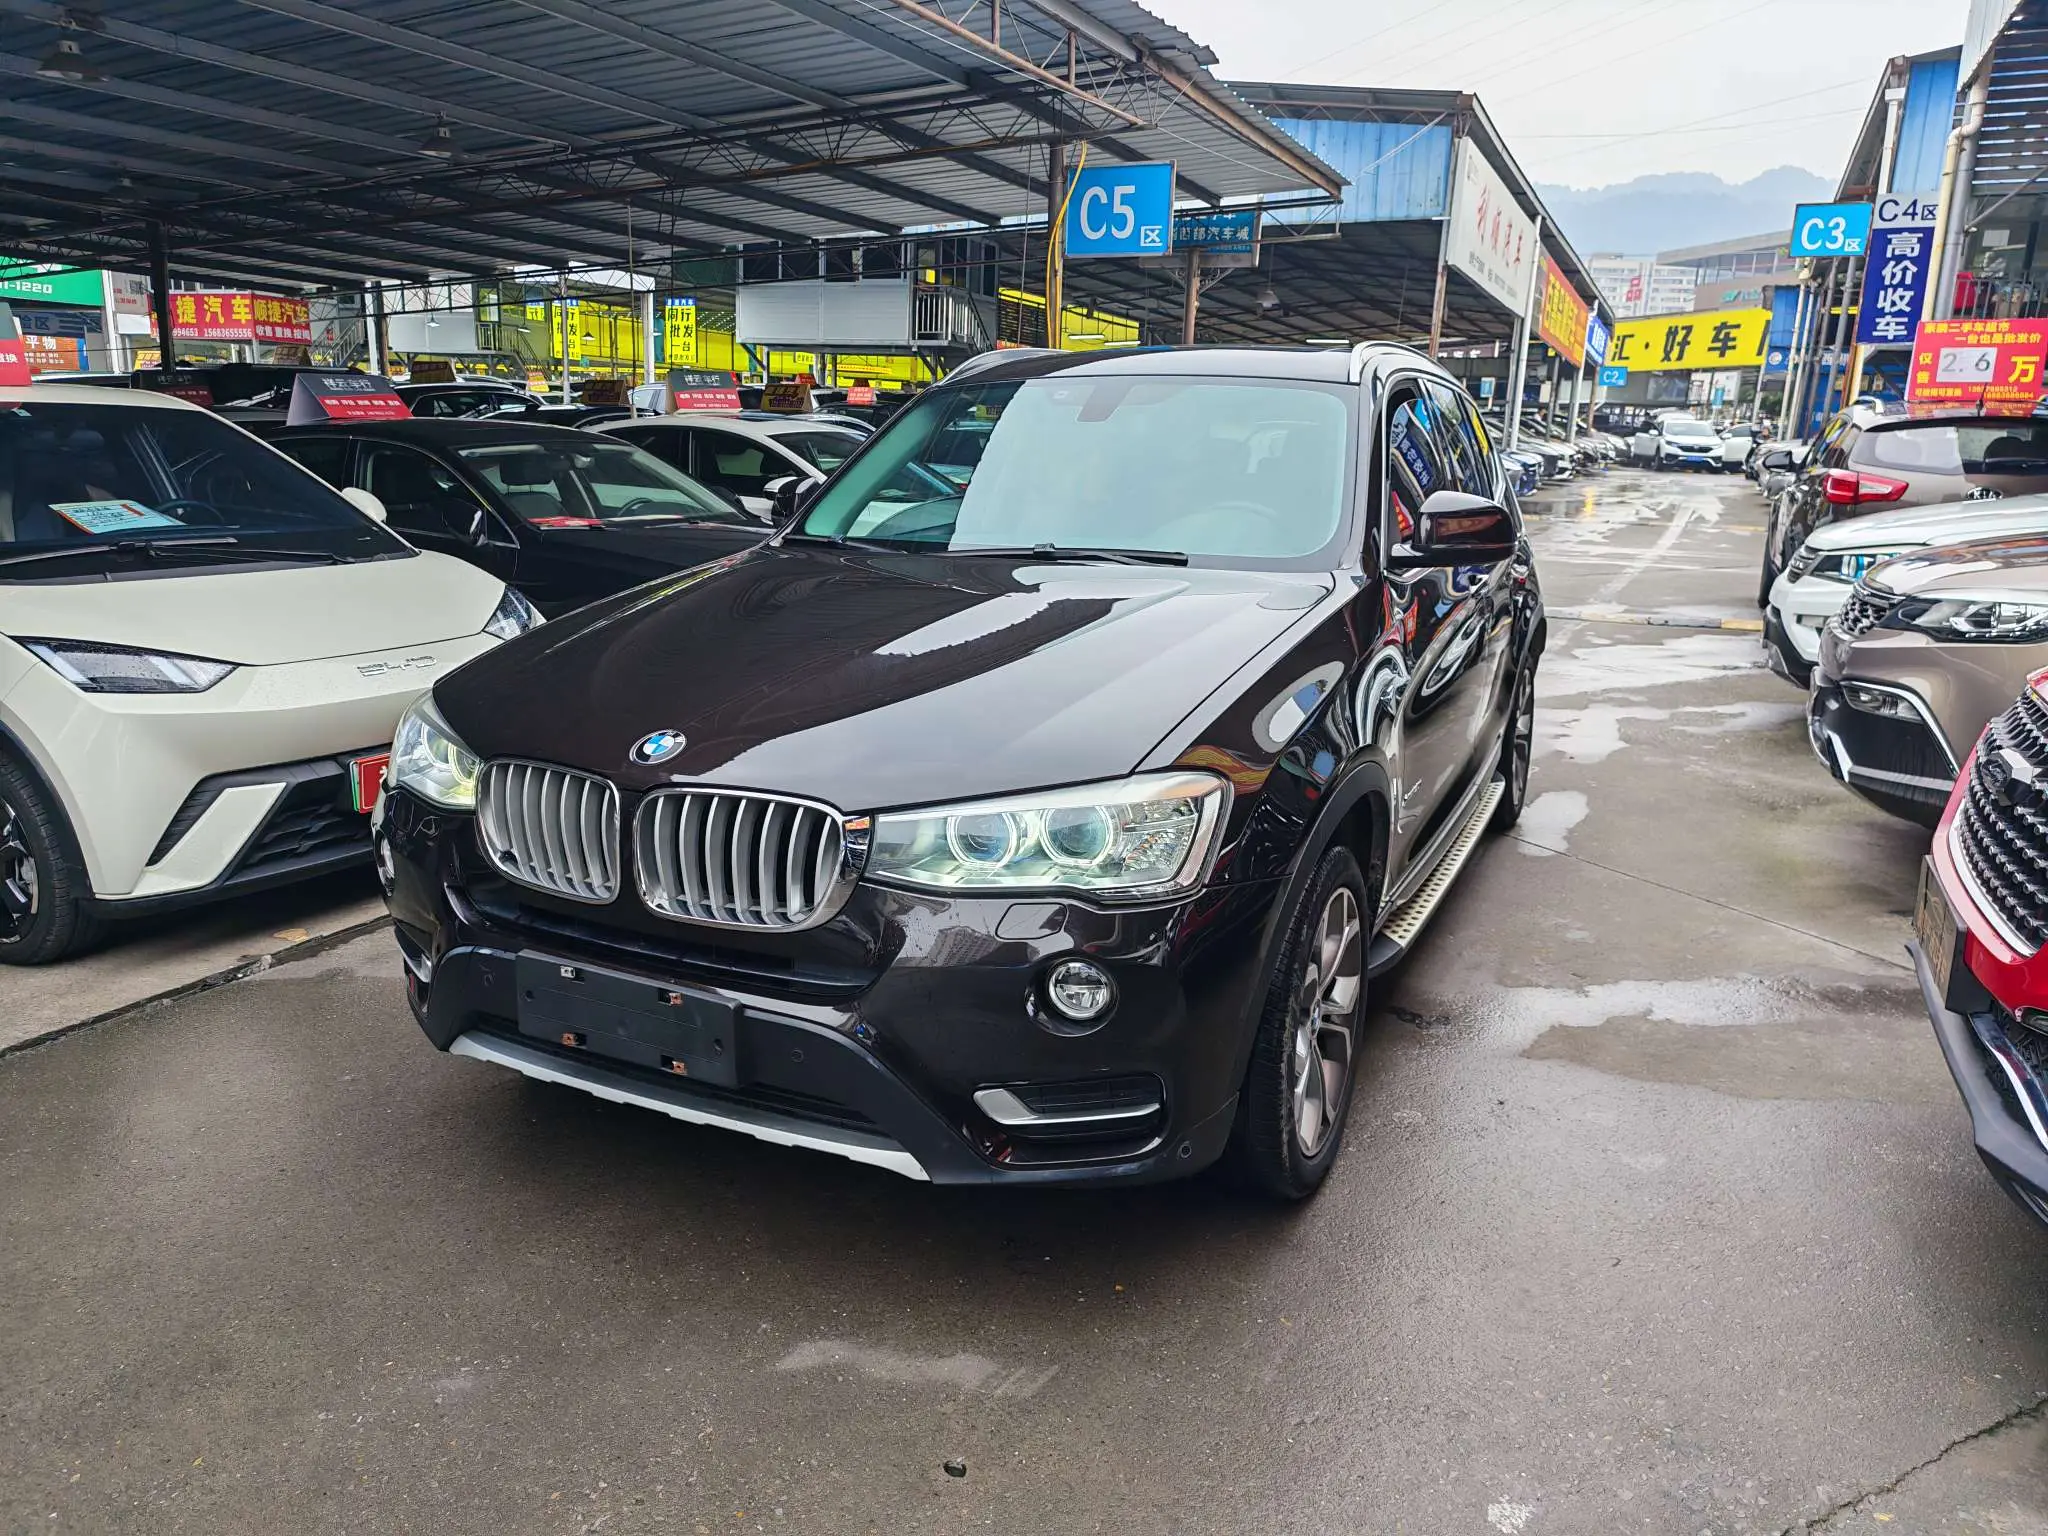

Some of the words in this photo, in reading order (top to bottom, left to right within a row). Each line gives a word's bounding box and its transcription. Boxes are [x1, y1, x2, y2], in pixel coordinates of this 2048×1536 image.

[1080, 185, 1163, 247] C5区
[1878, 198, 1938, 223] C4区
[1800, 216, 1862, 252] C3区
[1872, 231, 1924, 340] 高价收车
[151, 295, 252, 325] 捷汽车
[667, 308, 692, 322] 同行
[1941, 352, 1991, 372] 2.6
[2008, 355, 2041, 384] 万
[1970, 489, 1999, 500] KIA
[357, 655, 436, 677] BYD
